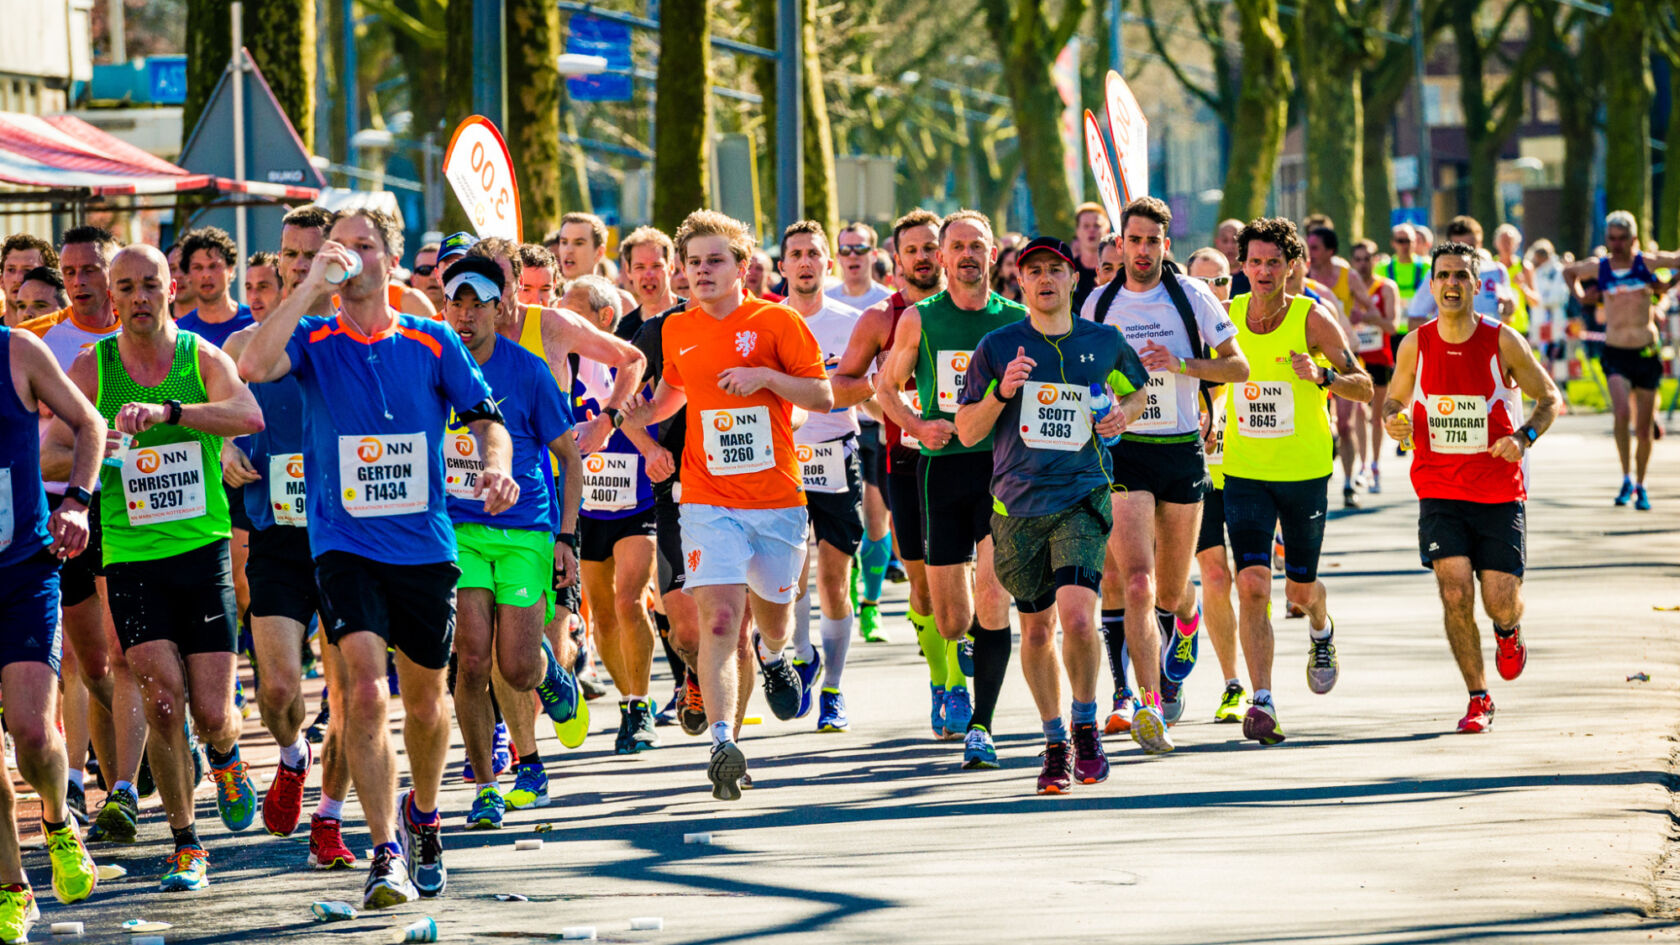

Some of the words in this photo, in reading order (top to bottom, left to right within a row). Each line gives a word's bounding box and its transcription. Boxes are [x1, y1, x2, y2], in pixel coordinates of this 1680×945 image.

[1126, 322, 1160, 331] nationale
[1126, 330, 1174, 339] nederlanden
[1061, 390, 1082, 402] NN
[1262, 386, 1282, 396] NN
[1248, 402, 1276, 413] HENK
[1458, 402, 1476, 410] NN
[1038, 408, 1076, 422] SCOTT
[1137, 406, 1162, 420] 618
[736, 414, 758, 426] NN
[1249, 414, 1276, 428] 8645
[1429, 416, 1486, 428] BOUTAGRAT
[1040, 422, 1072, 438] 4383
[1445, 430, 1468, 443] 7714
[720, 432, 754, 447] MARC
[386, 442, 412, 455] NN
[722, 446, 754, 464] 3260
[814, 448, 832, 458] NN
[162, 450, 188, 464] NN
[608, 460, 626, 469] NN
[804, 464, 824, 476] ROB
[357, 464, 412, 481] GERTON
[128, 470, 200, 494] CHRISTIAN
[286, 482, 306, 495] MA
[365, 482, 408, 502] F1434
[591, 489, 618, 502] 4007
[150, 489, 184, 510] 5297
[295, 497, 304, 514] 9
